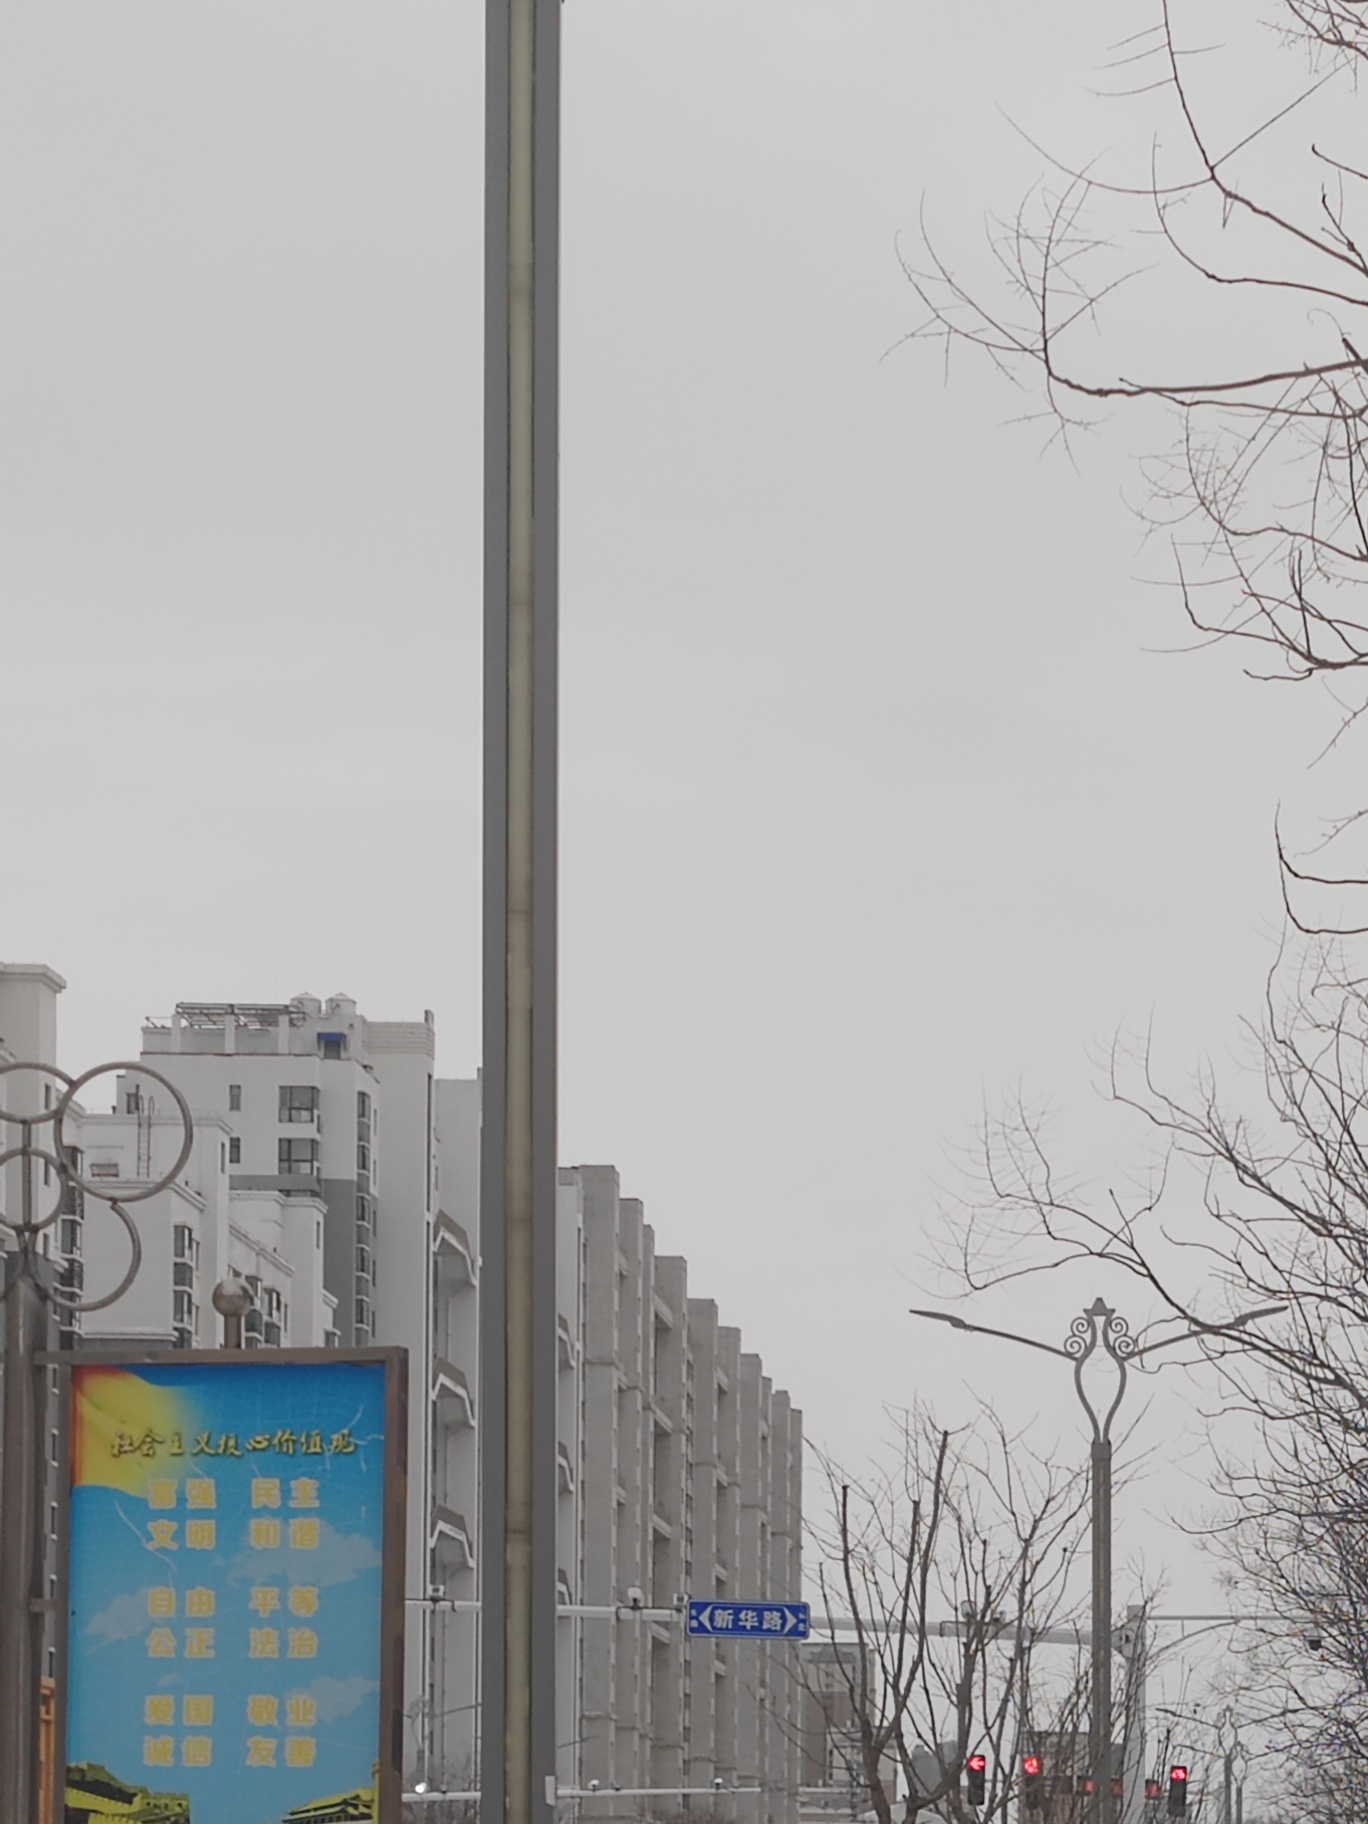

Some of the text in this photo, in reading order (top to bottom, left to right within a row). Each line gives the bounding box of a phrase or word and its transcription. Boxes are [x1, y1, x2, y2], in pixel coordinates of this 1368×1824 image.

[111, 1427, 356, 1457] 社会主义核心价值观
[148, 1476, 320, 1509] 富强 民主
[147, 1517, 320, 1550] 文明 和谐
[148, 1585, 319, 1618] 自由 平等
[713, 1608, 783, 1631] 新华路
[146, 1626, 318, 1659] 公正 法治
[144, 1694, 317, 1726] 爱国 敬业
[143, 1735, 317, 1767] 诚信 友善
